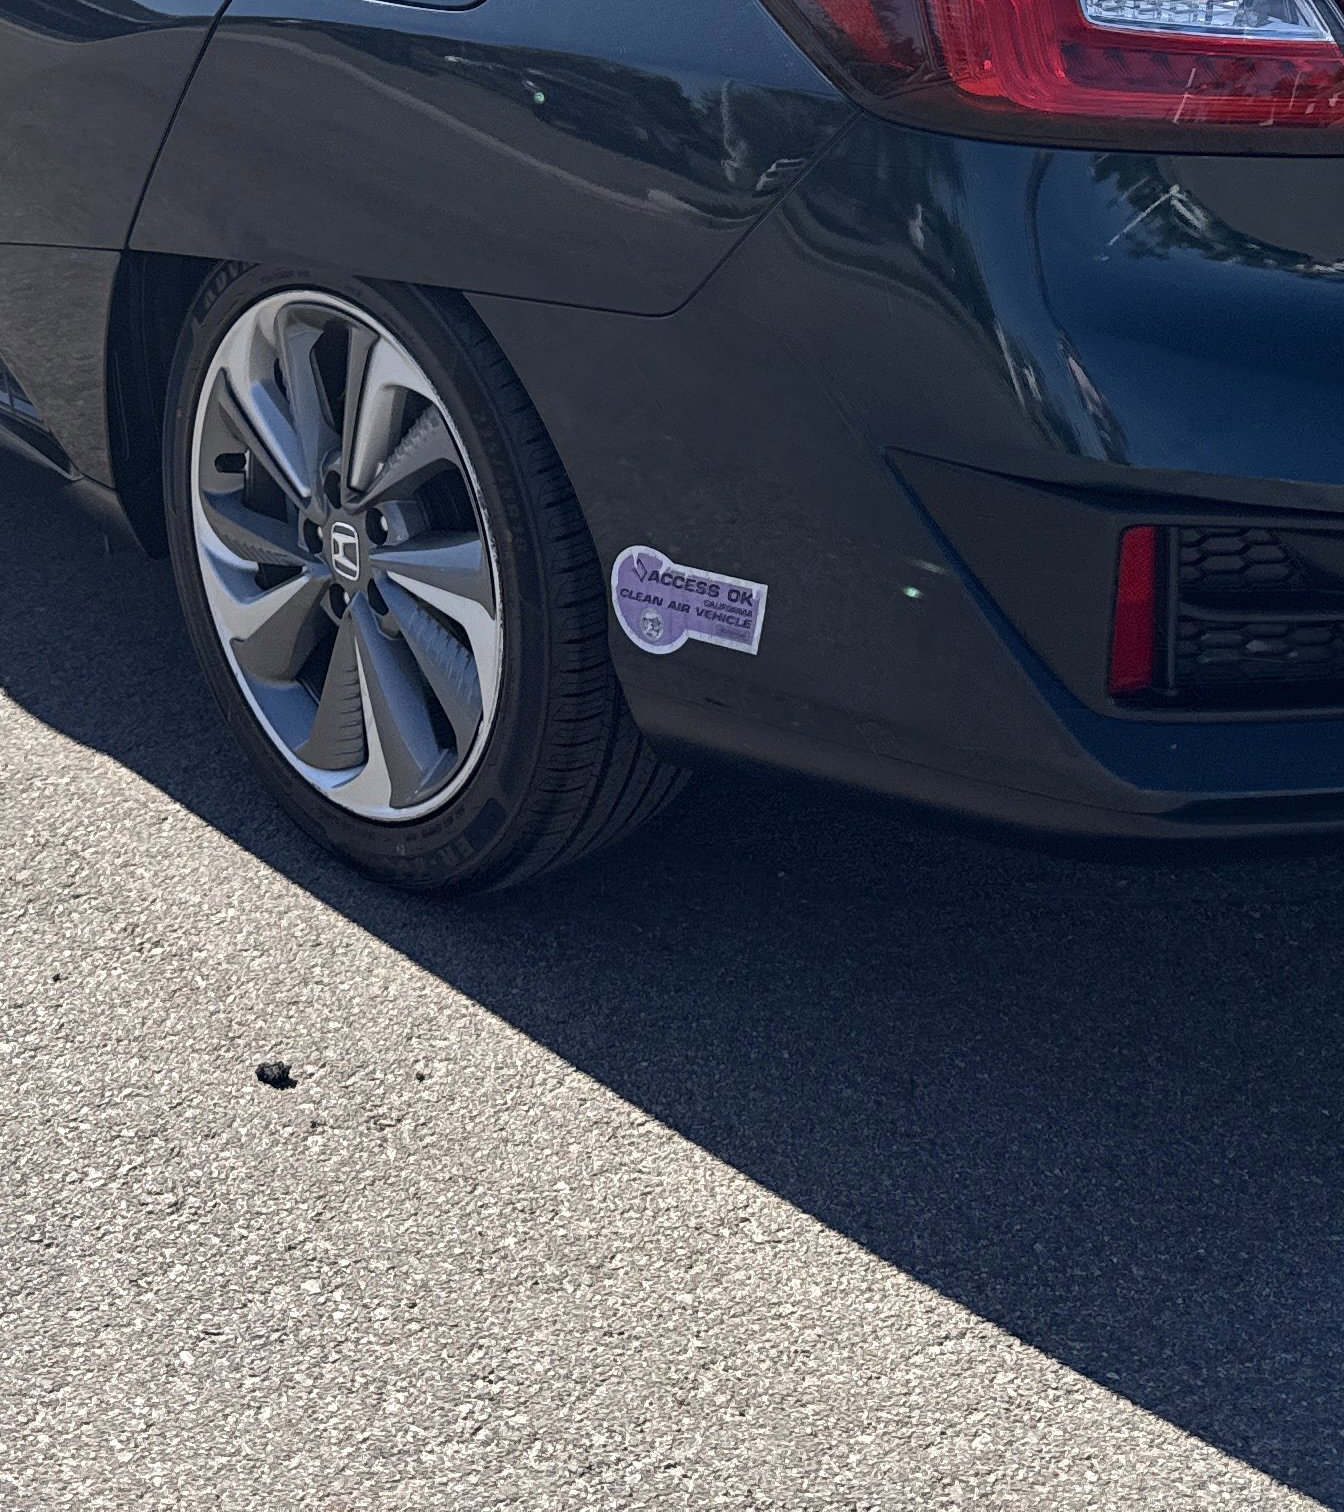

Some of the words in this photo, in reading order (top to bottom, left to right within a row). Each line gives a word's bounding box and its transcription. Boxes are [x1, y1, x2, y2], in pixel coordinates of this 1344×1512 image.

[648, 569, 720, 599] ACCESS
[727, 588, 754, 607] OK
[619, 587, 663, 607] CLEAN
[668, 599, 691, 614] AIR
[696, 606, 753, 630] VEHICLE
[704, 599, 753, 618] CALIFORNIA
